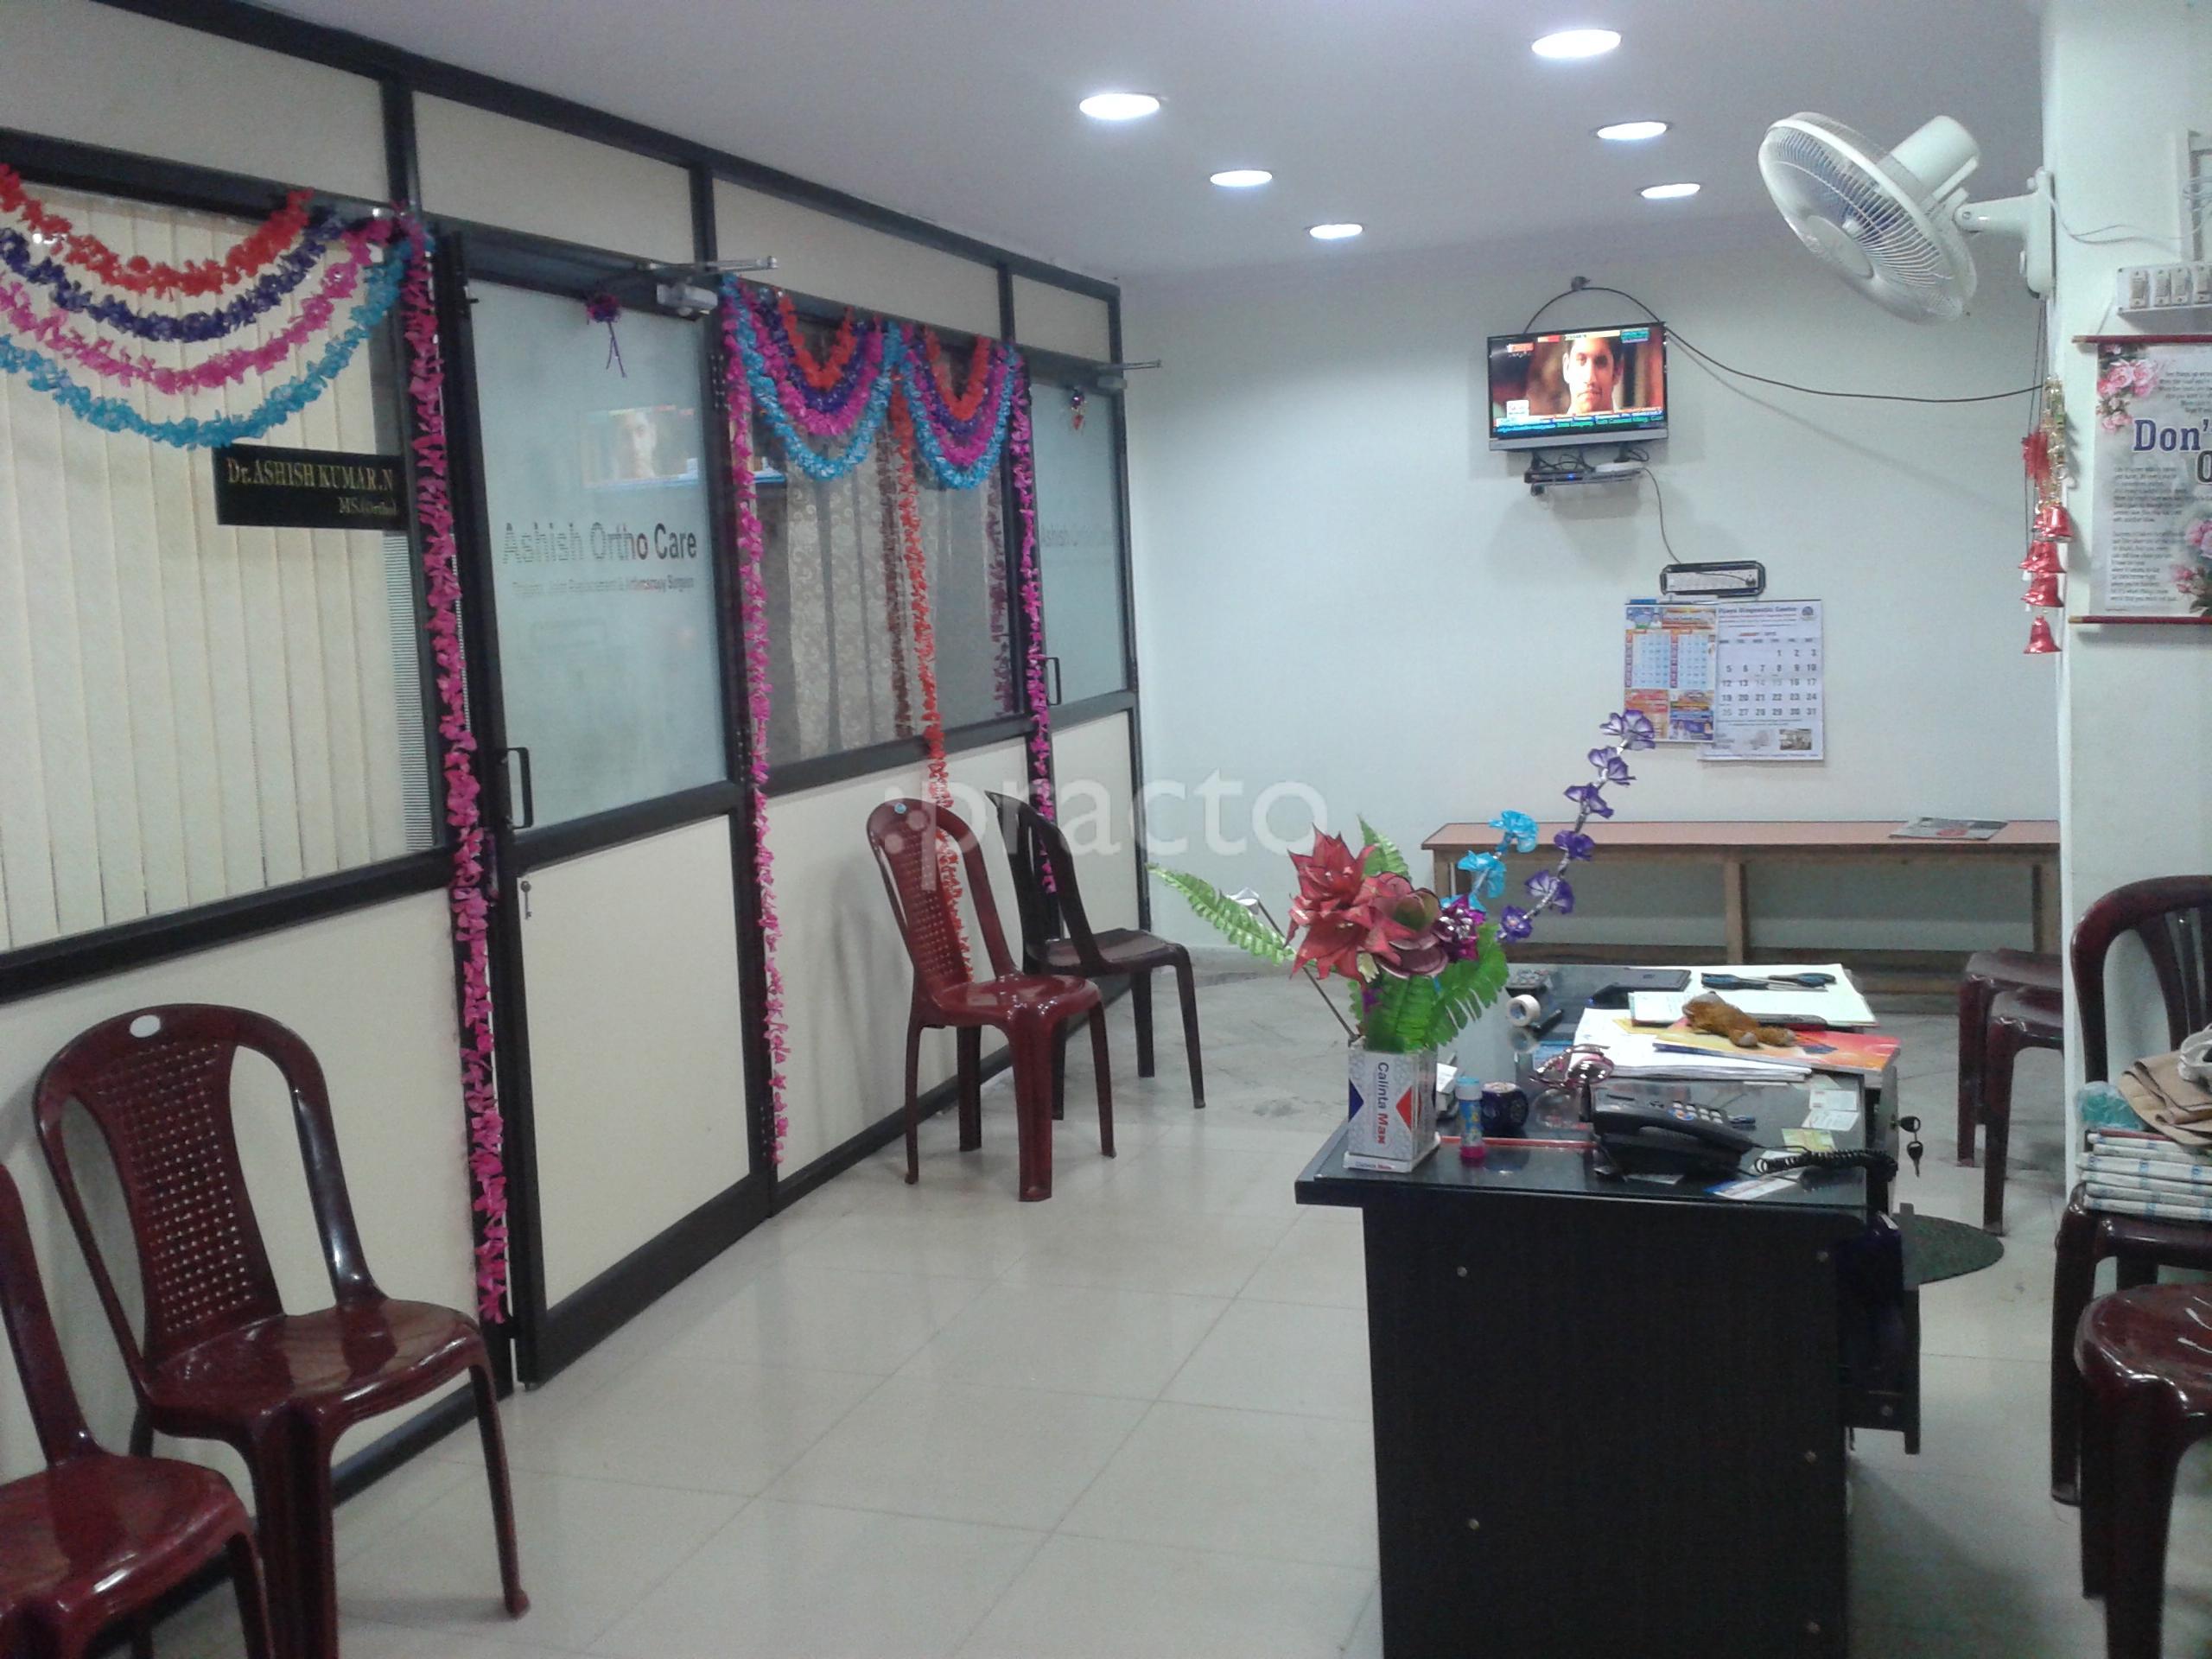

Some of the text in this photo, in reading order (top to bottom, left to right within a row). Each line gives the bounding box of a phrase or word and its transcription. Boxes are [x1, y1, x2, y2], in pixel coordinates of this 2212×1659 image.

[2133, 419, 2212, 451] Don'
[502, 521, 697, 563] Ashish Ortho Care
[1377, 1062, 1389, 1109] Calinta
